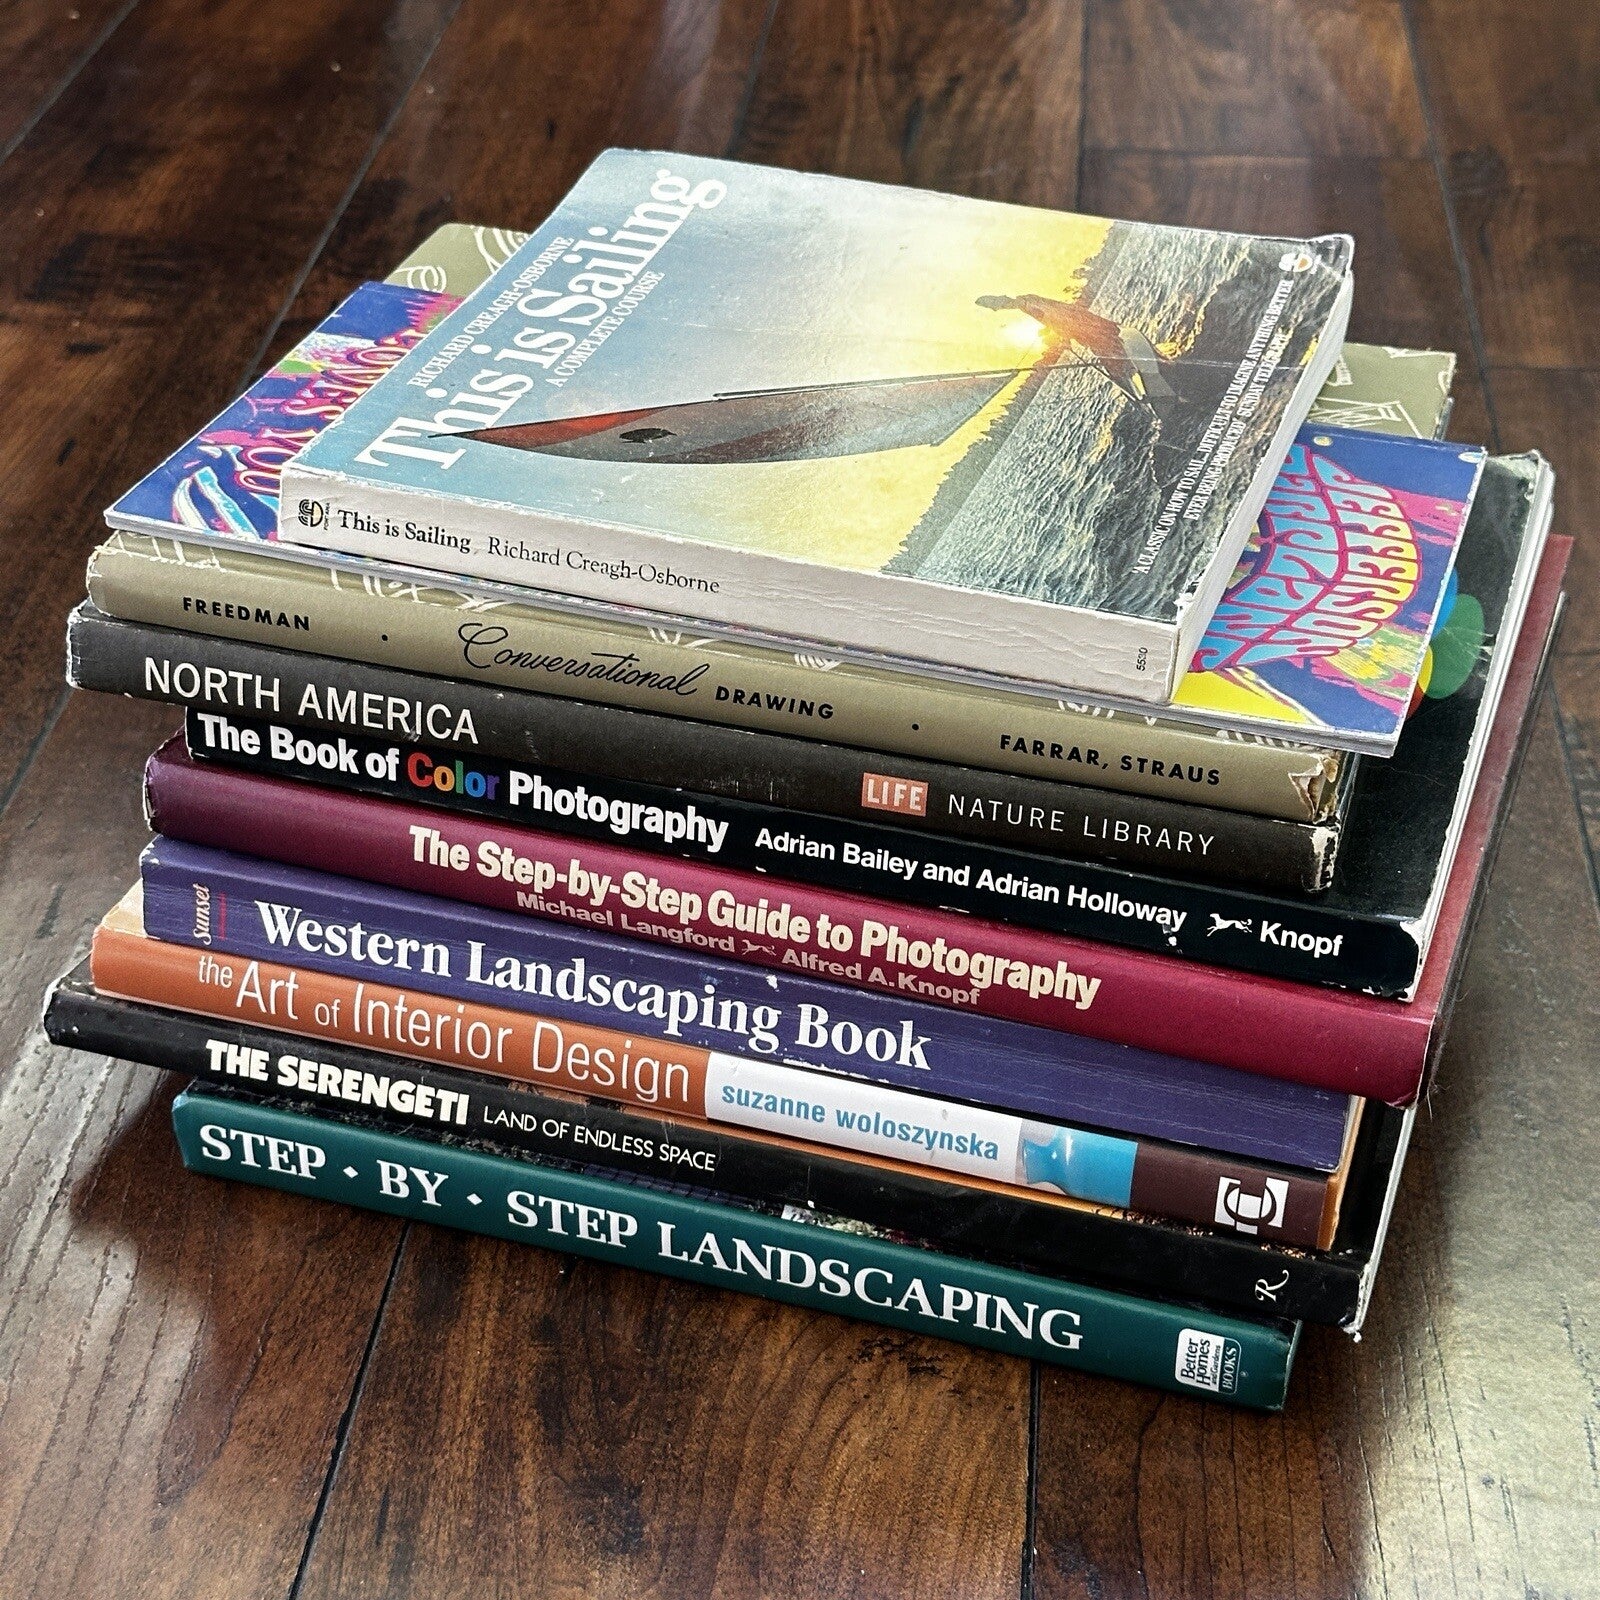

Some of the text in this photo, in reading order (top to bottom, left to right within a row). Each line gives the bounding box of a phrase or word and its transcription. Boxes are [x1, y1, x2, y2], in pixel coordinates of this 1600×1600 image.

[354, 168, 728, 470] This is Sailing
[406, 236, 576, 388] RICHARD CREAGH-OSBORNE
[545, 271, 665, 388] A COMPLETE COURSE
[1246, 315, 1276, 360] ANYTHING
[1266, 279, 1295, 320] BETTER
[1228, 359, 1257, 397] IMAGINE
[1178, 478, 1195, 492] TO
[1183, 494, 1205, 520] EVER
[1197, 467, 1222, 497] BEING
[1237, 382, 1265, 417] SUNDAY
[1158, 511, 1177, 528] ON
[1167, 491, 1188, 513] HOW
[337, 509, 720, 594] This is Sailing Richard Creagh-Osborne
[1138, 523, 1171, 565] CLASSIC
[183, 597, 310, 632] FREEDMAN
[145, 657, 479, 744] NORTH AMERICA
[458, 622, 835, 720] Conversational DRAWING
[1000, 734, 1221, 786] FARRAR, STRAUS
[197, 712, 1344, 958] The Book of Color Photography Adrian Bailey and Adrian Holloway Knopf
[867, 778, 1215, 855] LIFE NATURE LIBRARY
[192, 883, 212, 945] Sunset
[408, 825, 1102, 1010] The Step-by-Step Guide to Photography
[517, 891, 614, 927] Michael
[621, 913, 735, 953] Langford
[781, 947, 862, 979] Alfred
[254, 899, 932, 1071] Western Landscaping Book
[198, 955, 999, 1162] the Art of Interior Design suzanne woloszynska
[205, 1039, 717, 1172] THE SERENGETI LAND OF ENDLESS SPACE
[199, 1123, 1084, 1351] STEP BY STEP LANDSCAPING
[1181, 1338, 1199, 1380] Better
[1196, 1338, 1211, 1386] Homes
[1222, 1346, 1237, 1390] BOOKS
